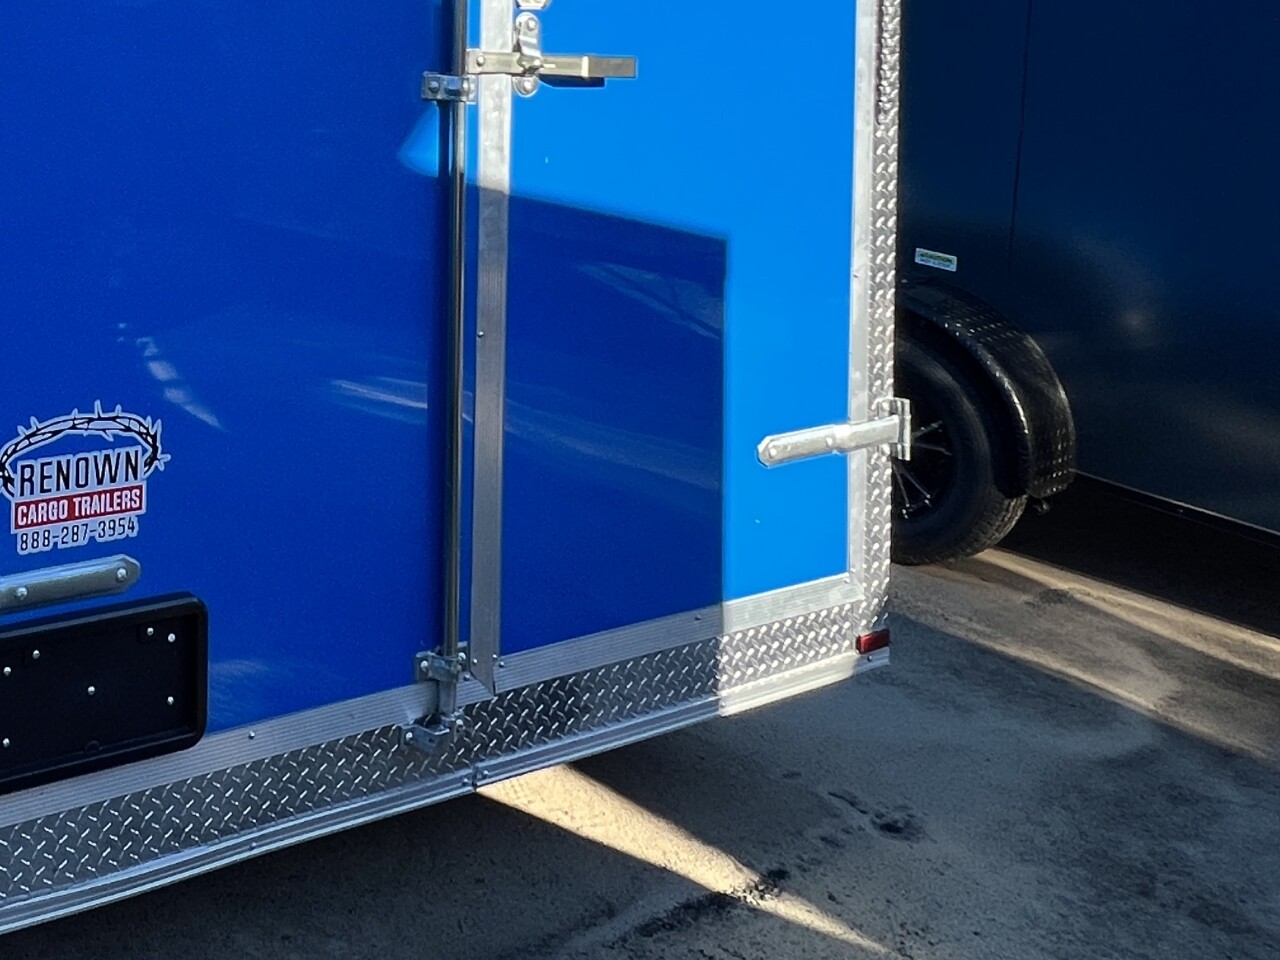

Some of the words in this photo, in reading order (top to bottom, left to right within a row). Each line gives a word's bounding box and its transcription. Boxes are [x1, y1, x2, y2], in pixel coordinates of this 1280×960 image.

[19, 450, 139, 497] RENOWN
[17, 499, 69, 526] CARGO
[73, 489, 140, 517] TRAILERS
[20, 516, 136, 552] 888-287-3954
